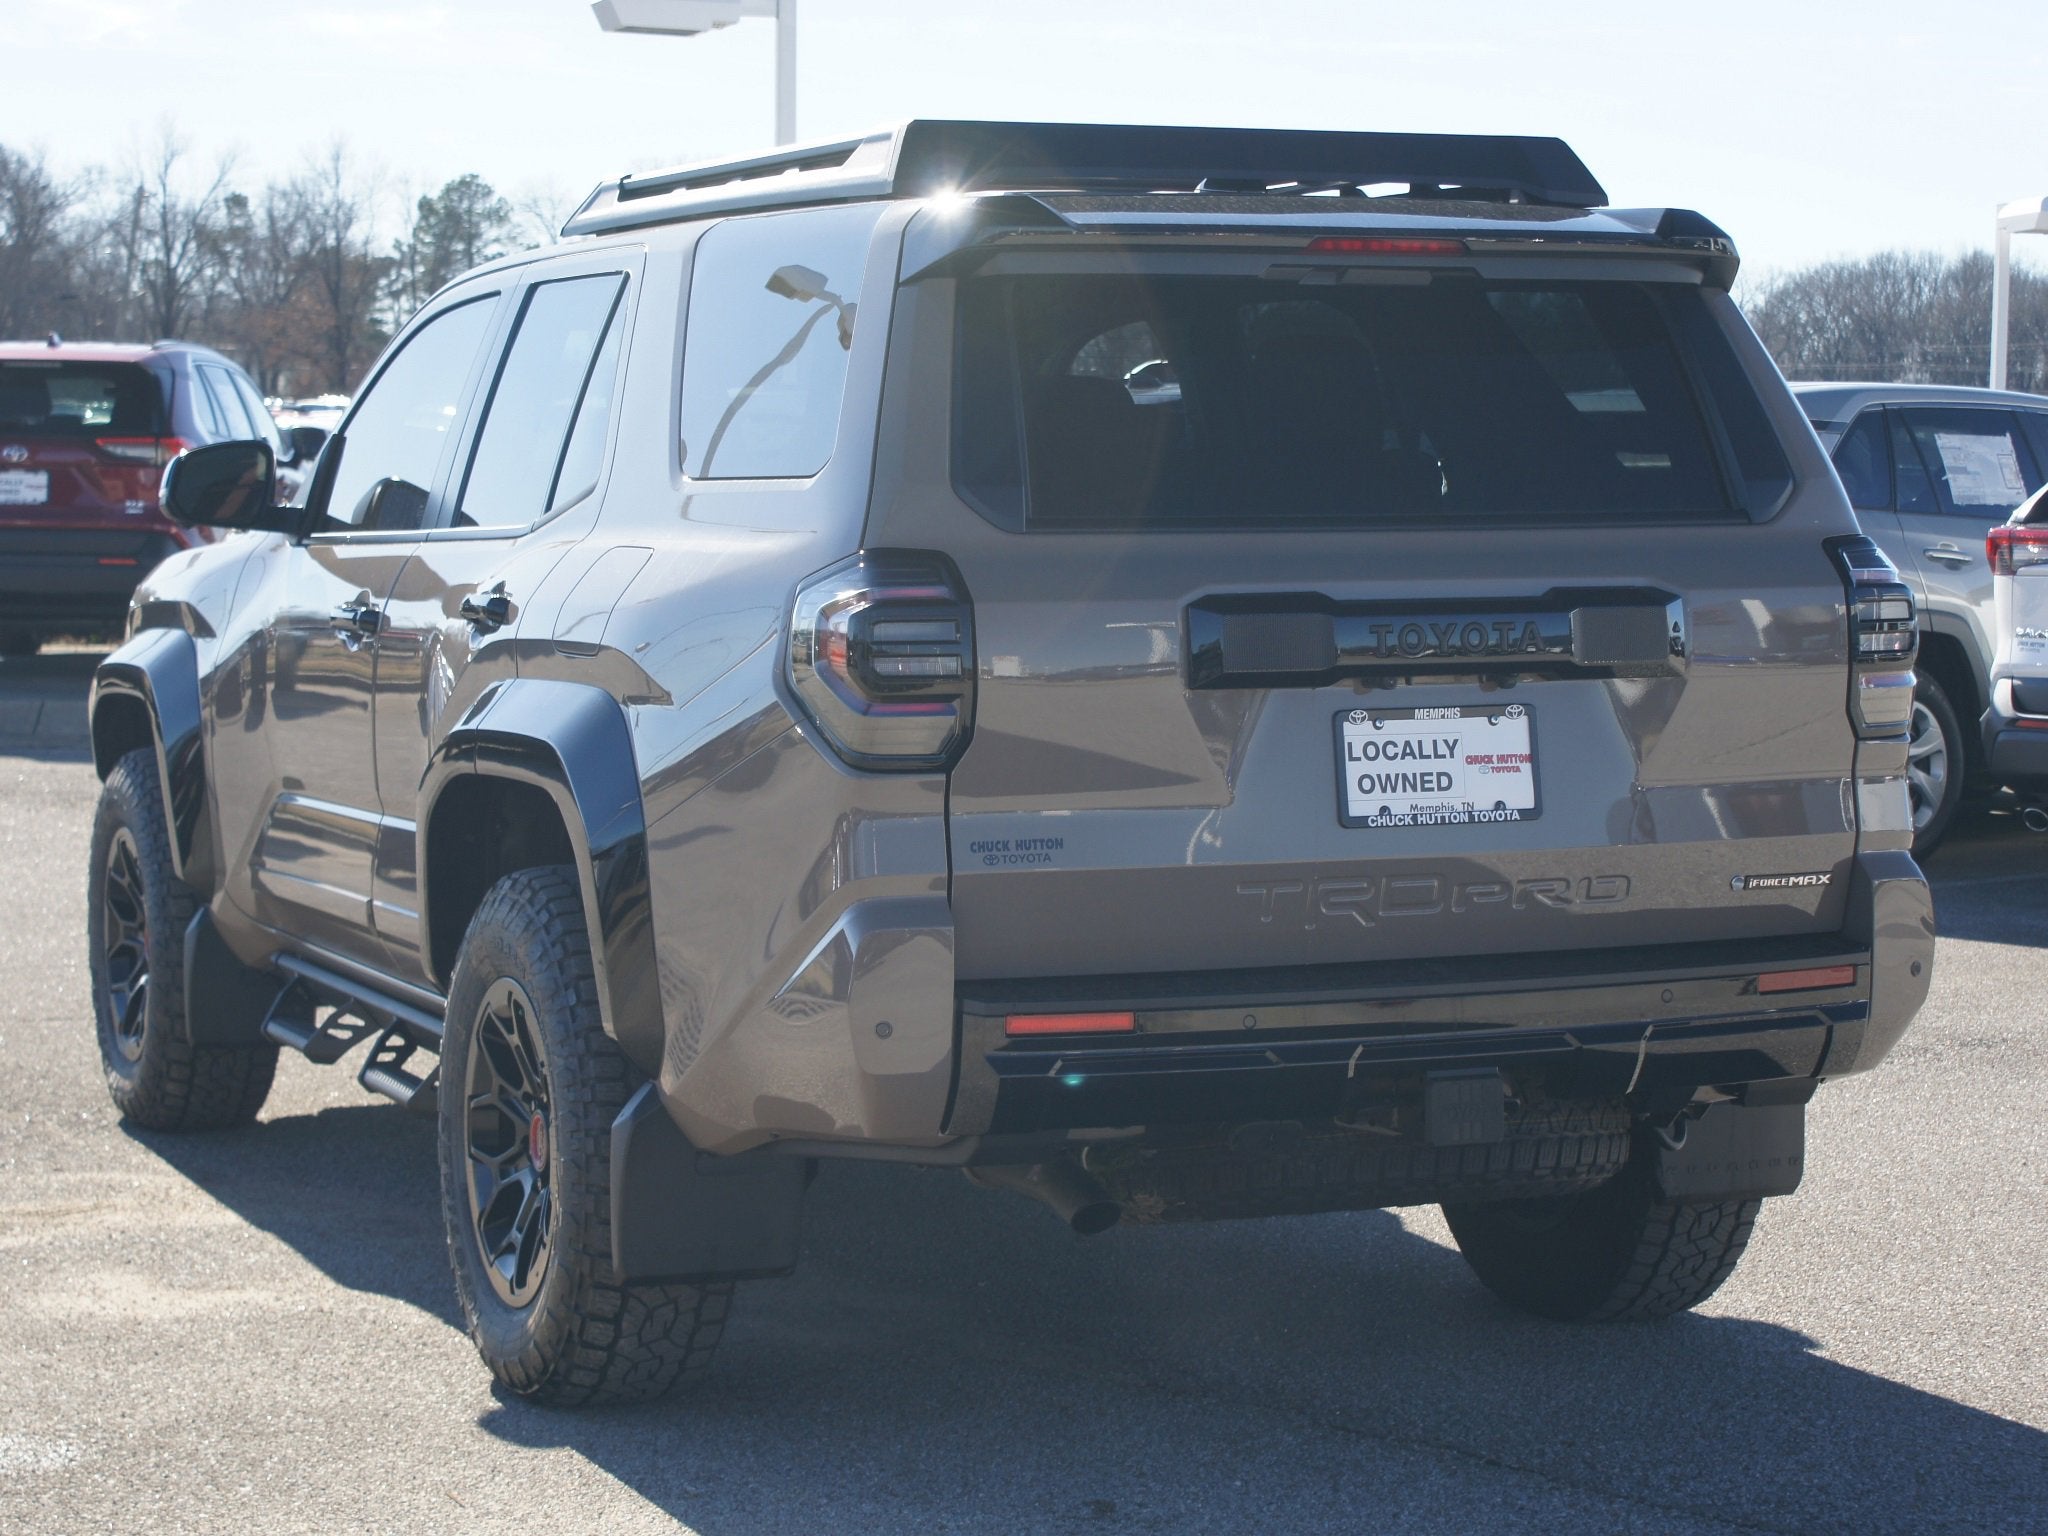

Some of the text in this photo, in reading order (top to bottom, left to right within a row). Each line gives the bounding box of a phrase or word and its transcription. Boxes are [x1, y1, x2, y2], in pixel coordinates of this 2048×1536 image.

[1369, 620, 1546, 658] TOYOTA
[1414, 707, 1461, 720] MEMPHIS
[1347, 738, 1459, 762] LOCALLY
[1465, 753, 1533, 766] CHUCK HUTTON
[1491, 765, 1521, 774] TOYOTA
[1357, 771, 1453, 794] OWNED
[1461, 802, 1475, 811] TN
[1367, 809, 1520, 827] CHUCK HUTTON TOYOTA
[970, 838, 1064, 853] CHUCK HUTTON
[1001, 853, 1052, 864] TOYOTA
[1236, 873, 1446, 930] TRD
